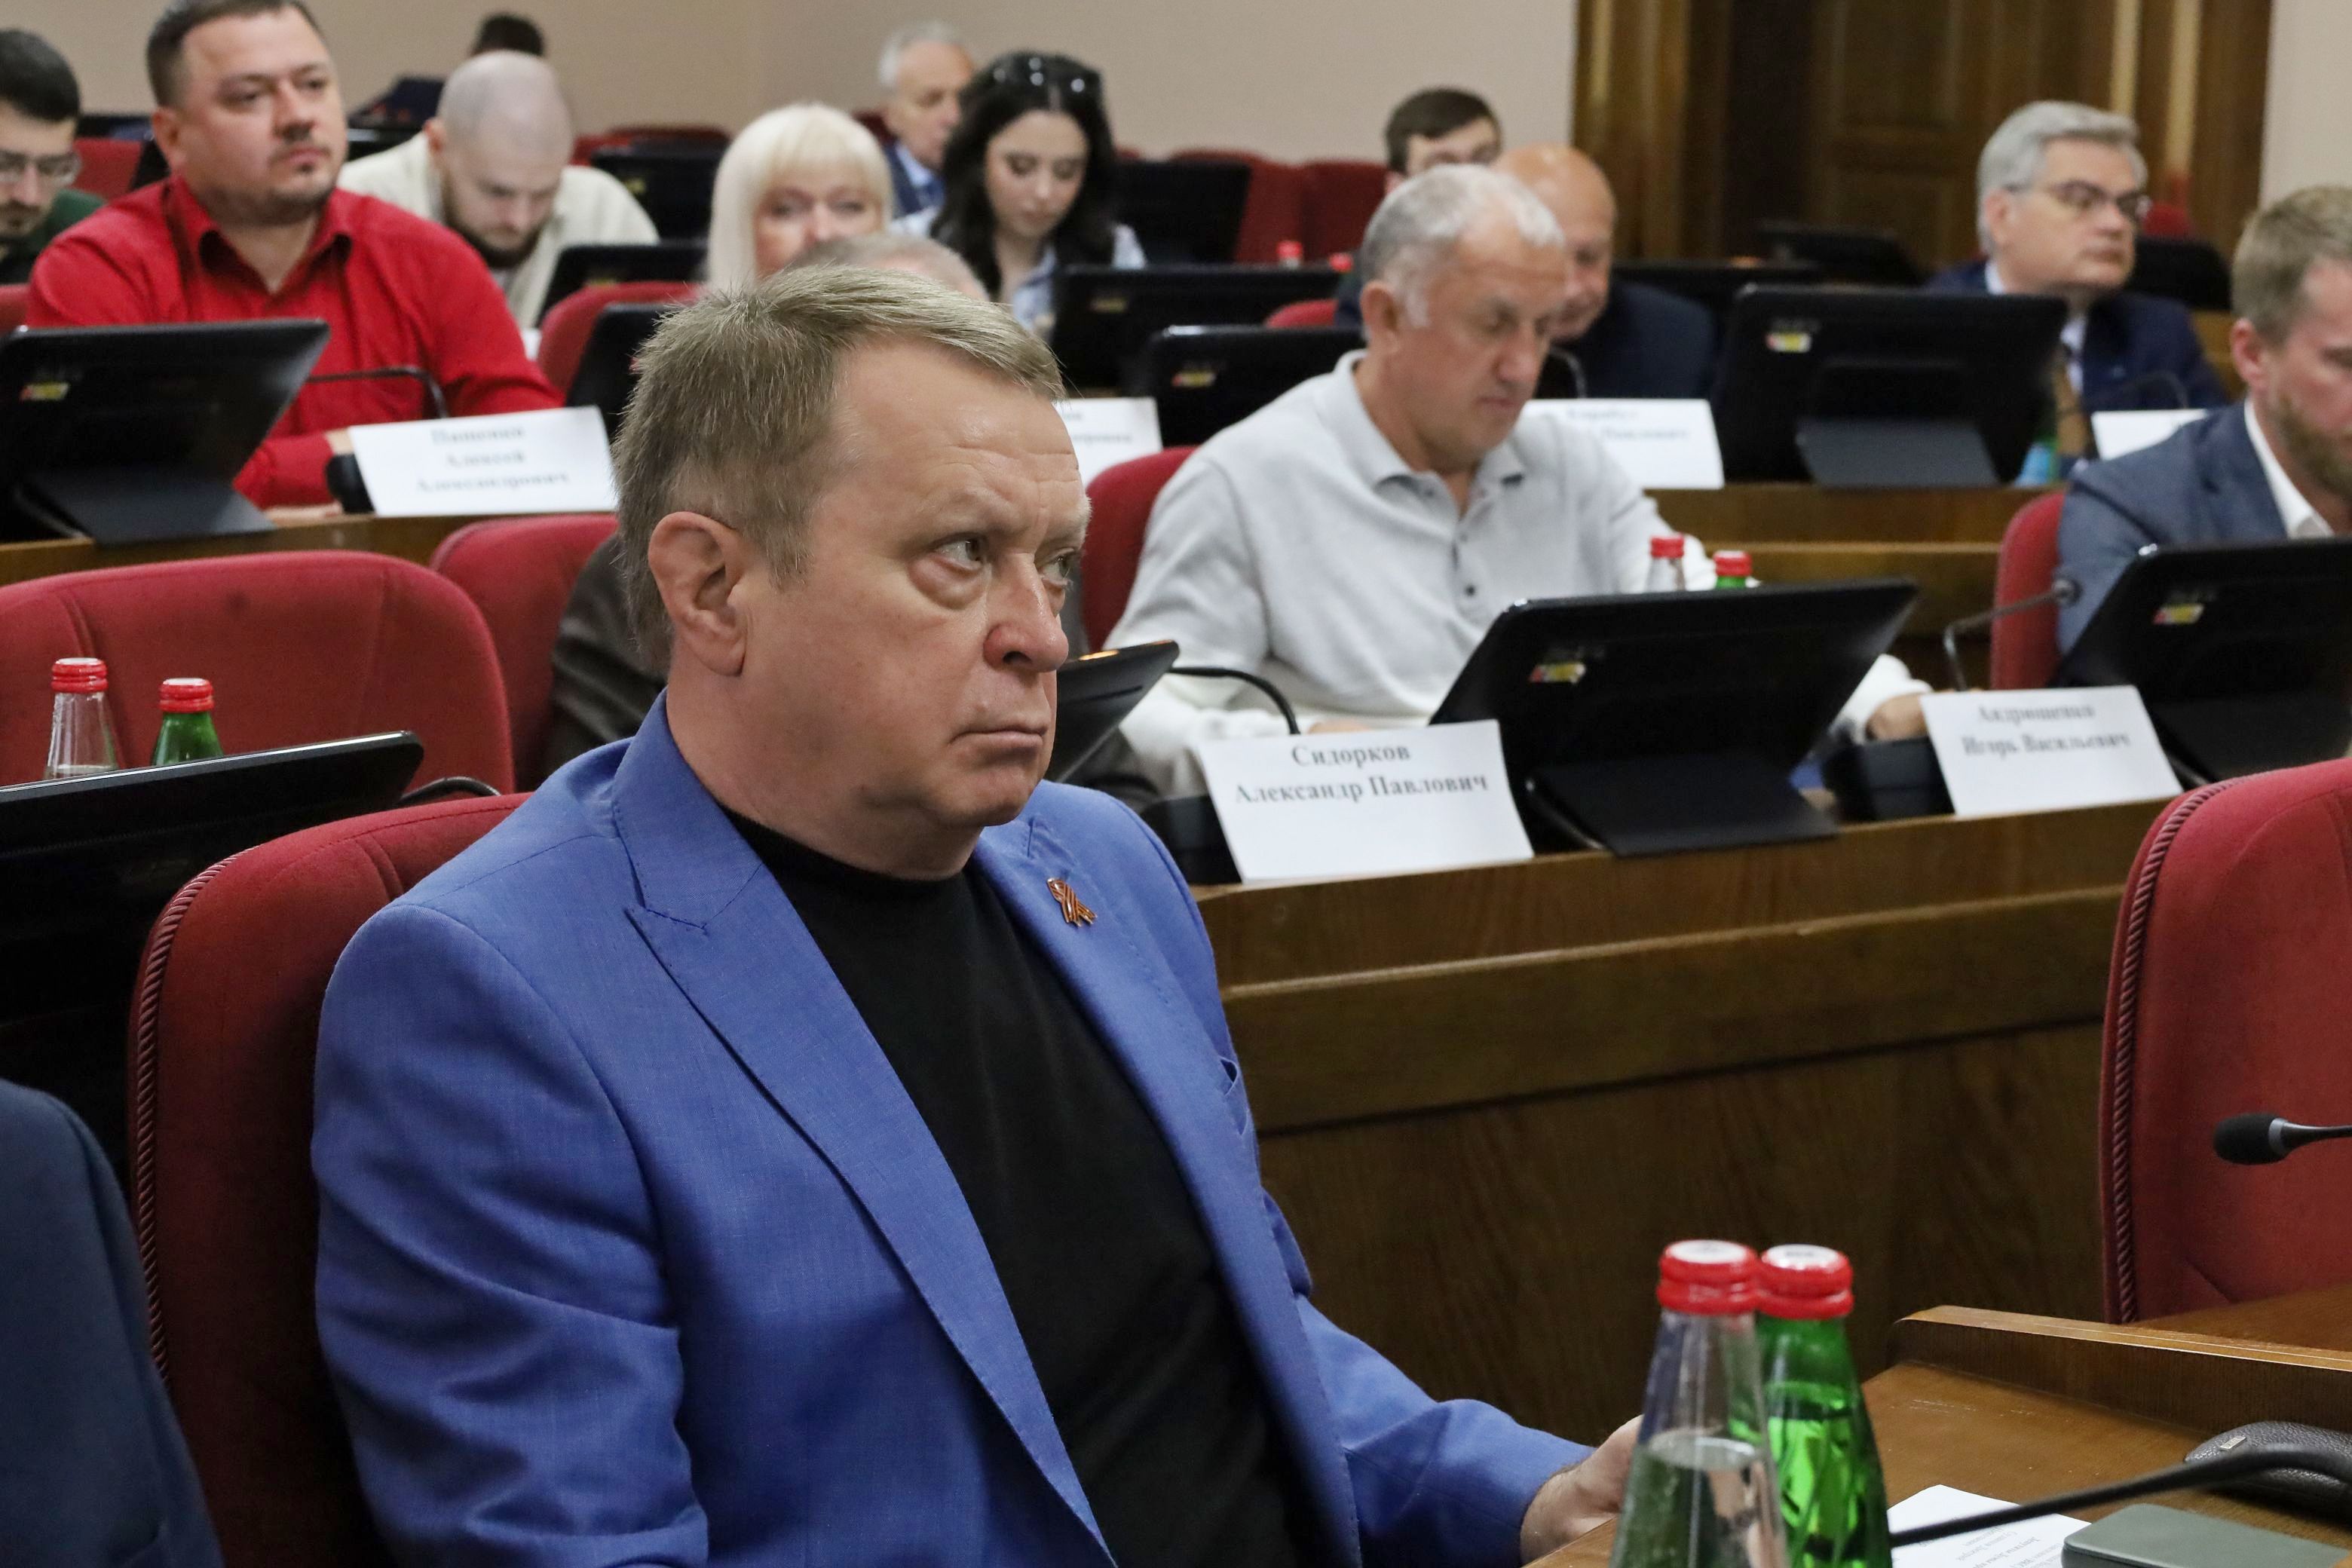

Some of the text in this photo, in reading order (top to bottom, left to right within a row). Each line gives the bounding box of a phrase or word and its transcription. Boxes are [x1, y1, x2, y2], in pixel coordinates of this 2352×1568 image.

[1291, 743, 1410, 769] Сидорков
[1962, 731, 2132, 761] Игорь Васильевич
[1235, 773, 1488, 805] Александр Павлович
